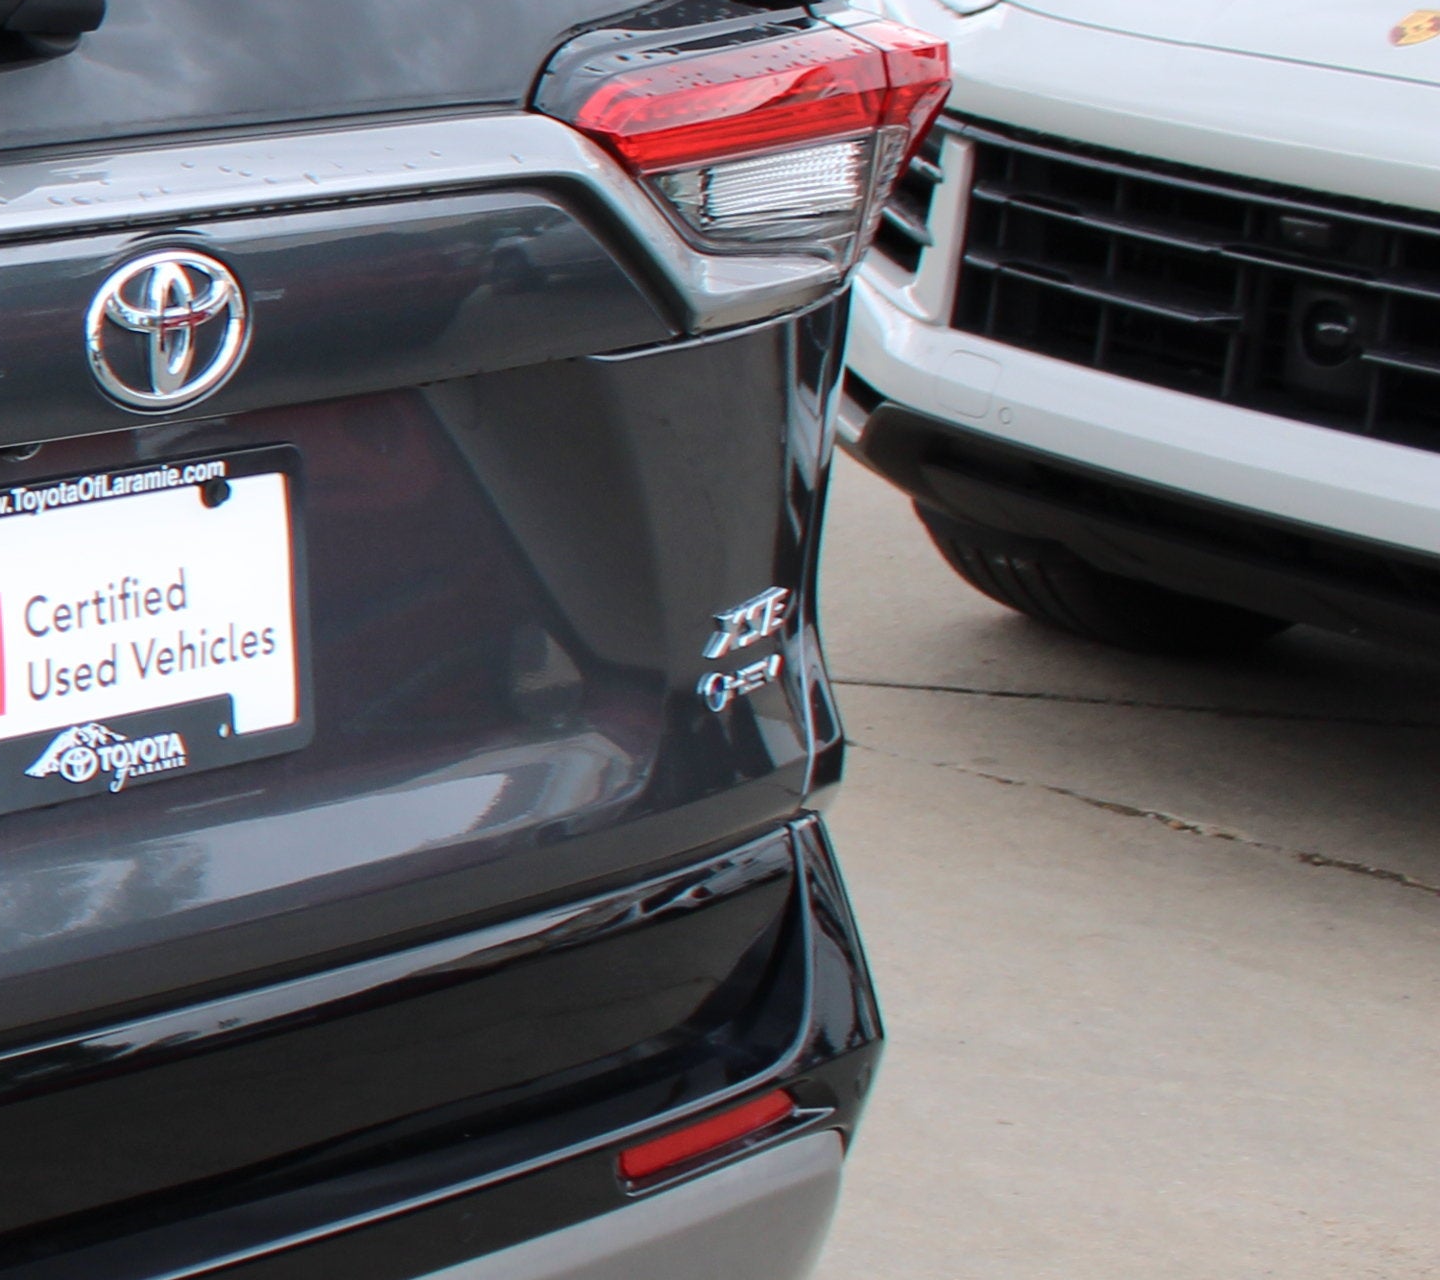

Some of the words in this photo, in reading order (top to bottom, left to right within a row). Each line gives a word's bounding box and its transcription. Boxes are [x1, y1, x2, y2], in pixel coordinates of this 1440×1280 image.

[24, 567, 186, 637] Certified
[27, 642, 117, 701] Used
[130, 622, 276, 680] Vehicles
[96, 732, 187, 771] TOYOTA
